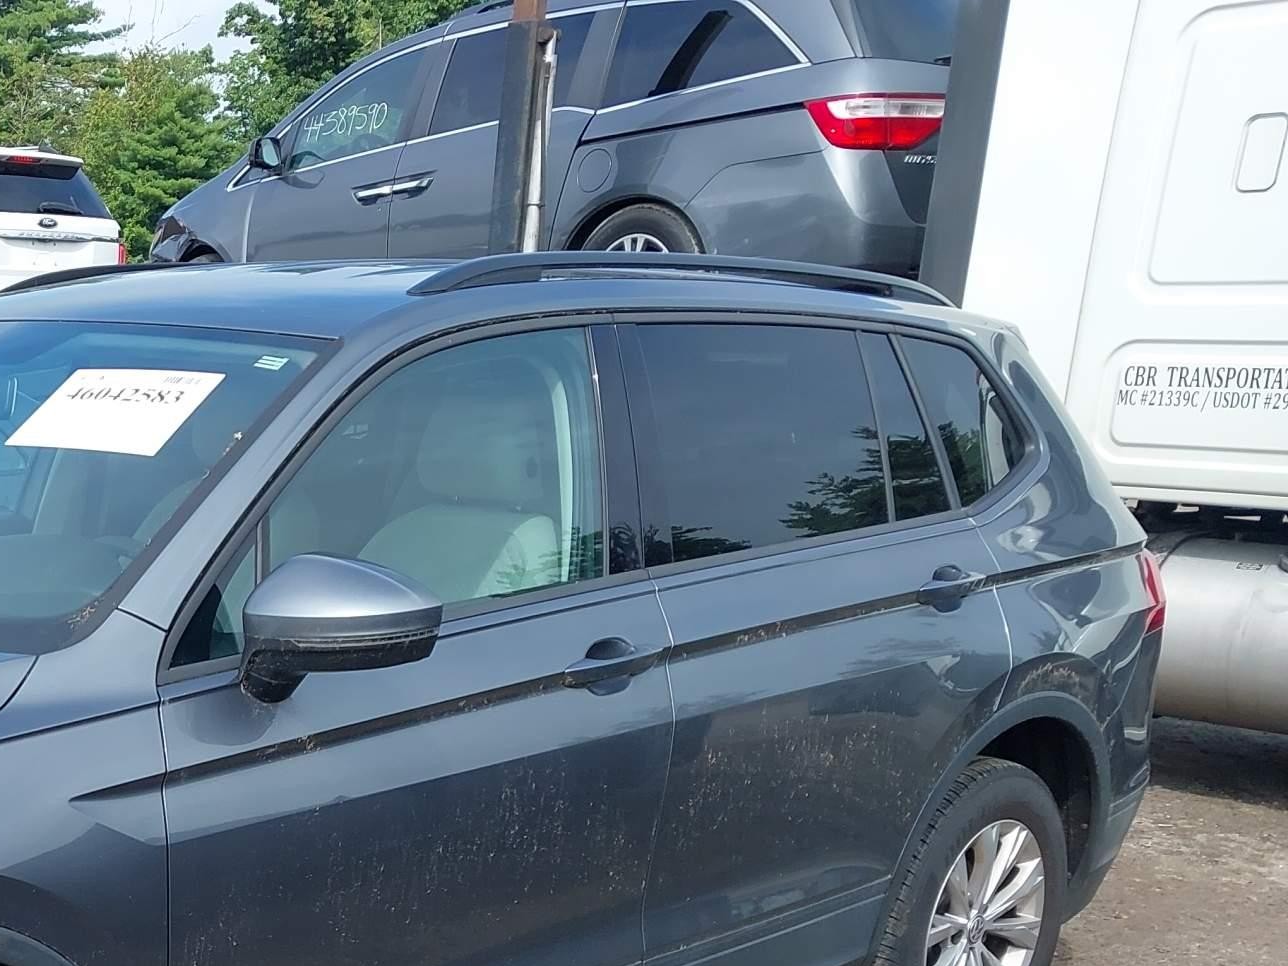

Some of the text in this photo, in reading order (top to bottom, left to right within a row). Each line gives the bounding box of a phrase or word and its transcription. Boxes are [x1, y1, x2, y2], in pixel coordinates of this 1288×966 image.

[303, 102, 388, 143] 44389590
[1124, 365, 1157, 387] CBR
[67, 387, 185, 404] 46042583
[1117, 389, 1138, 406] MC
[1140, 389, 1200, 408] #21339C
[1213, 391, 1261, 409] USDOT
